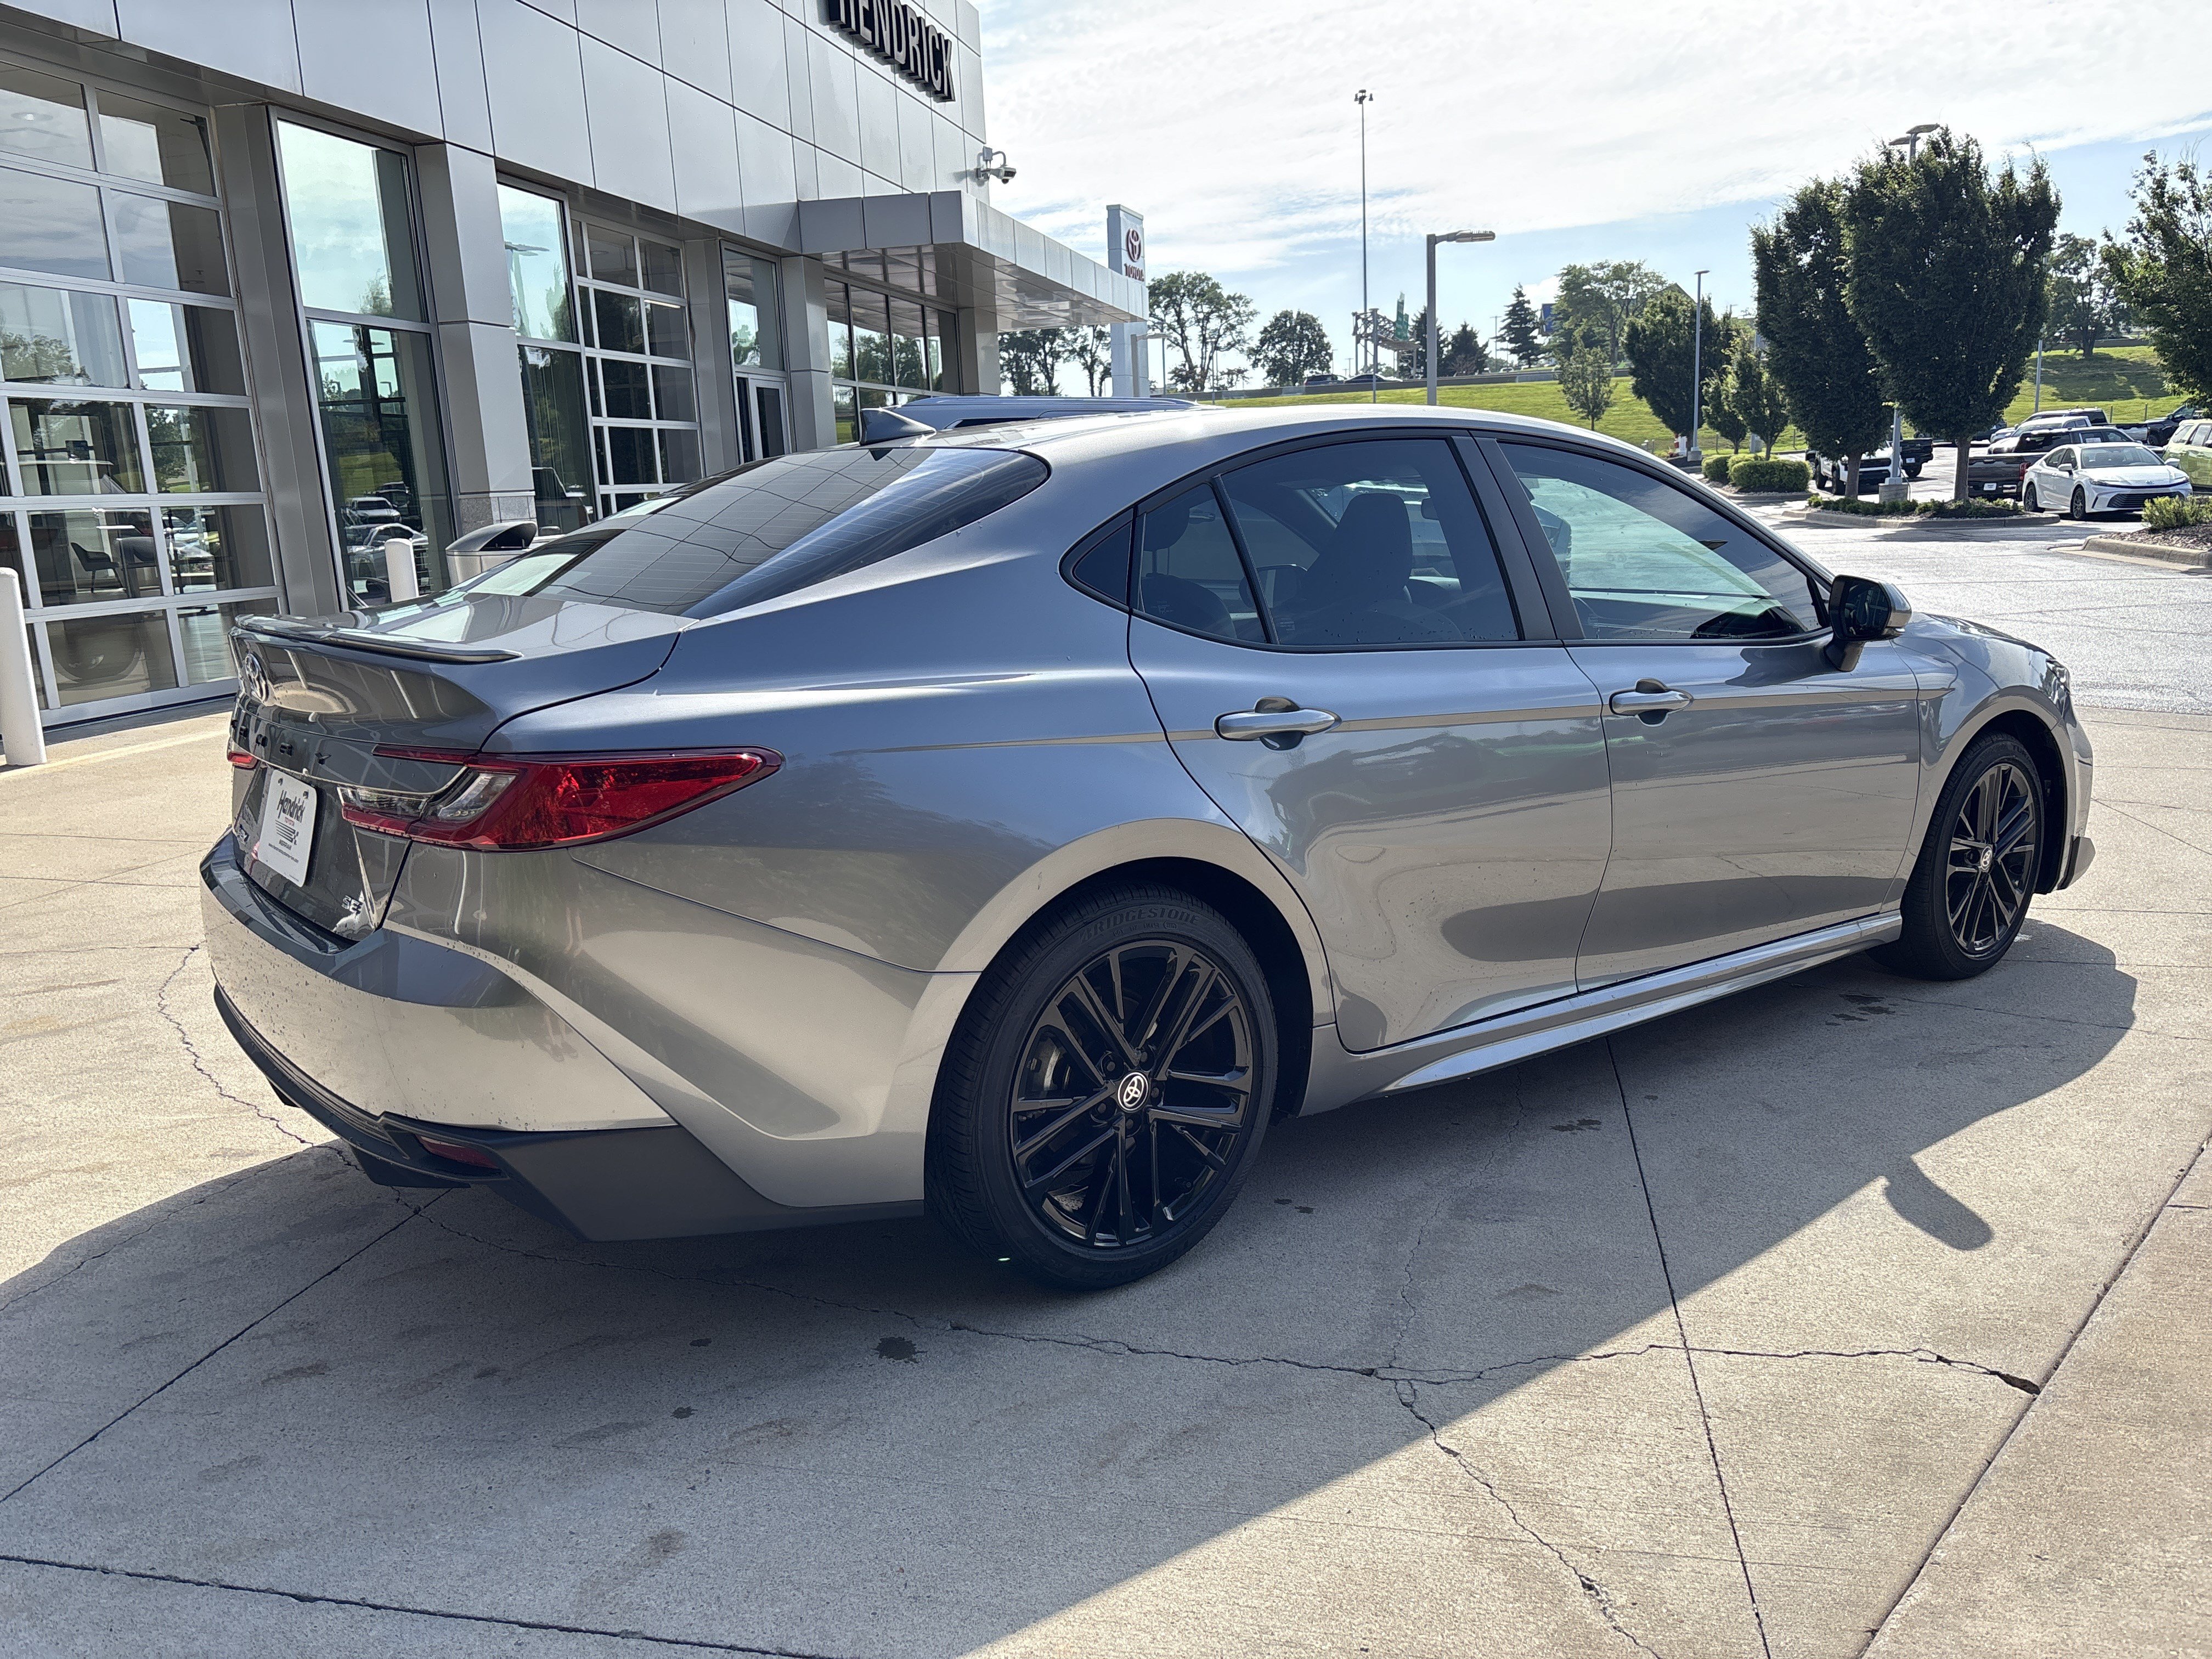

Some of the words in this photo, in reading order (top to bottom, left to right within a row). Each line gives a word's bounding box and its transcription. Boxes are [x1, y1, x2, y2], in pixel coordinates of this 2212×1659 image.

[1124, 263, 1144, 281] TOYOTA
[276, 790, 305, 823] Hendrick
[341, 895, 362, 915] SE
[1079, 907, 1201, 944] BRIDGESTONE
